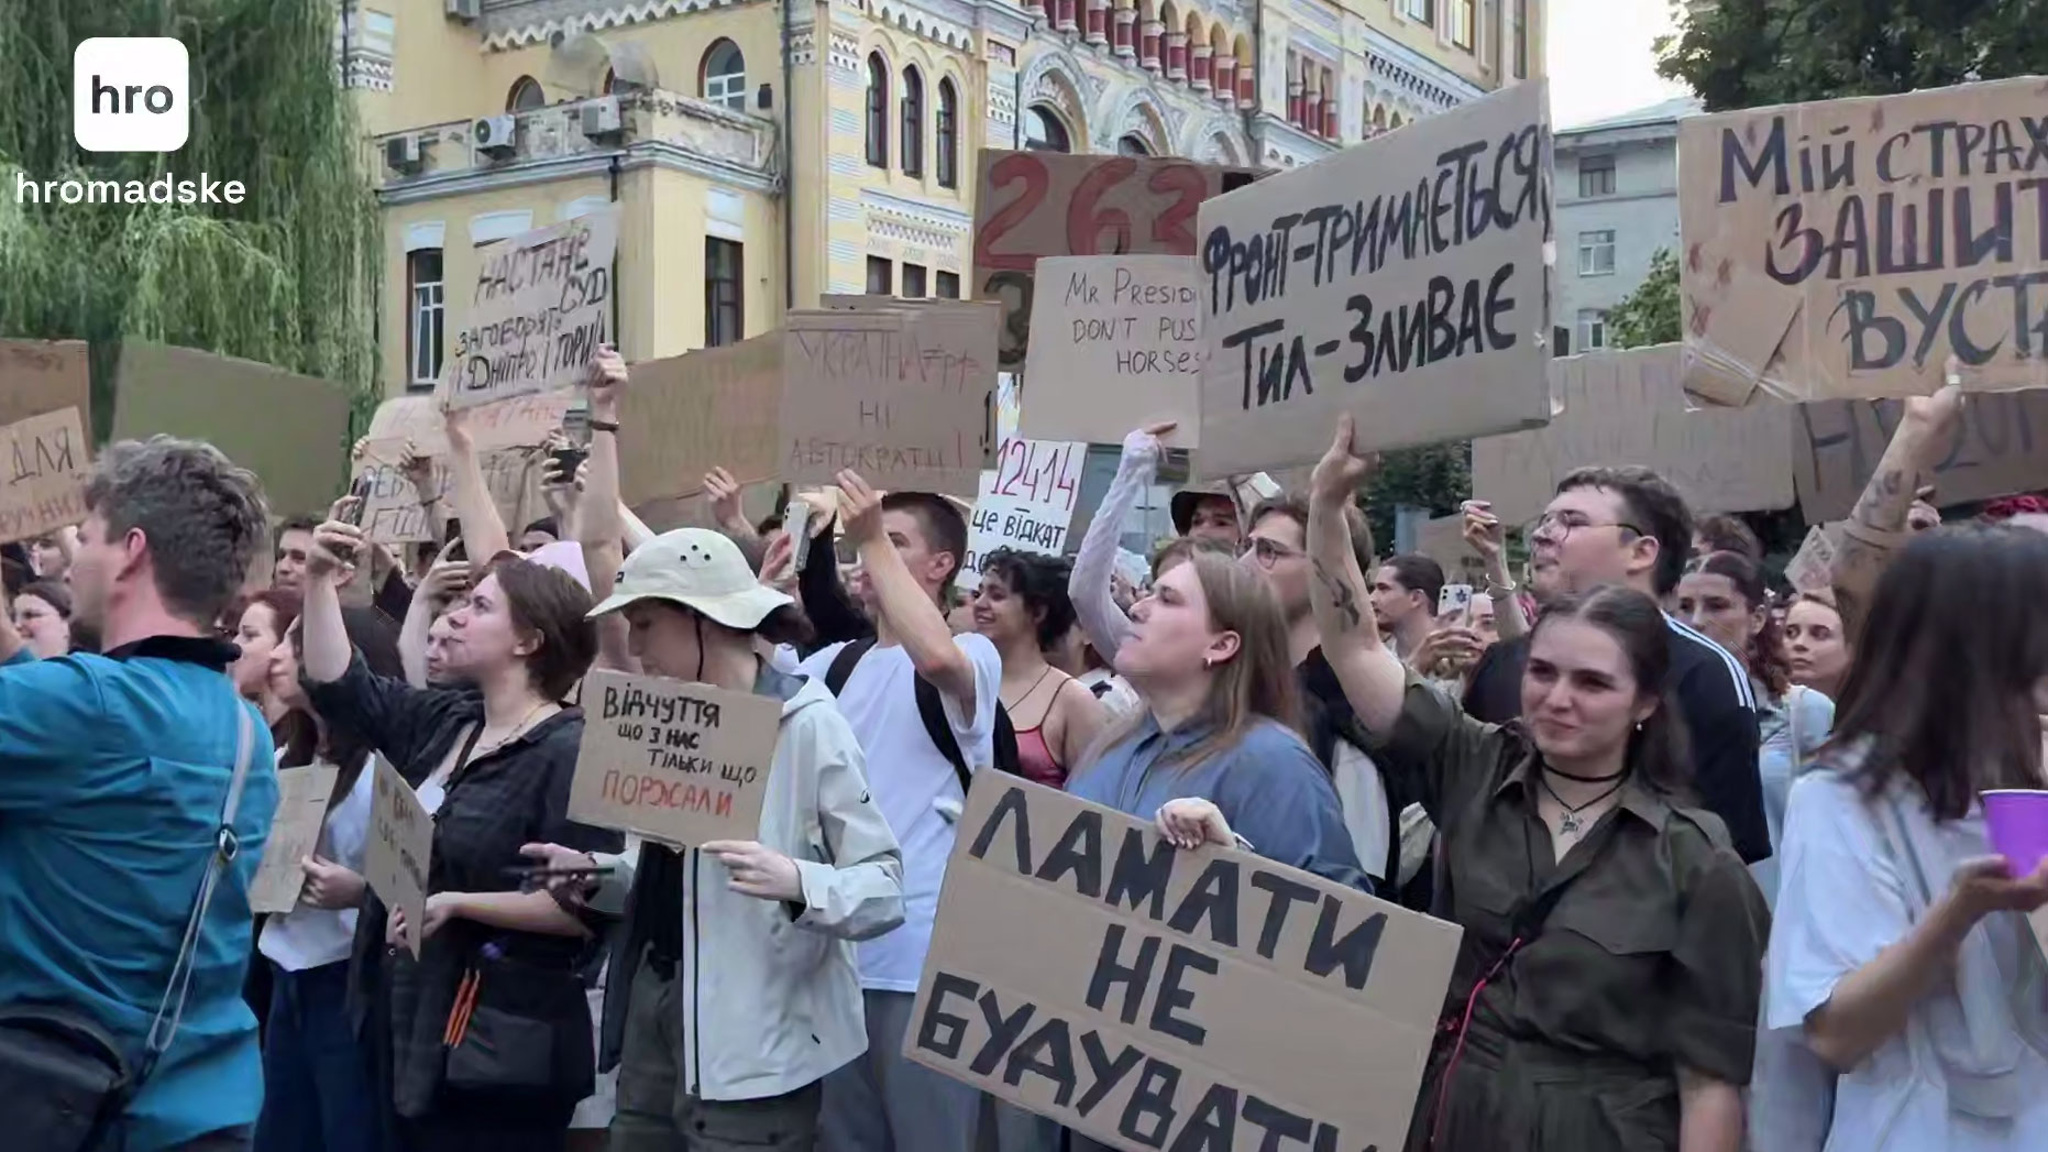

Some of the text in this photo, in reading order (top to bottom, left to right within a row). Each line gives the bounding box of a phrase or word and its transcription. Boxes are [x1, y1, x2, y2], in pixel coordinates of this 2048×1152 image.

[560, 267, 607, 313] СУД
[1158, 315, 1196, 342] PUS
[9, 426, 74, 487] ДЛЯ
[991, 437, 1075, 511] 12414
[603, 683, 720, 728] ВІДЧУТТЯ
[648, 749, 713, 774] ТІЛЬКИ
[666, 729, 700, 750] НАС
[969, 787, 1388, 990] ЛАМАТИ
[1085, 924, 1218, 1045] НЕ
